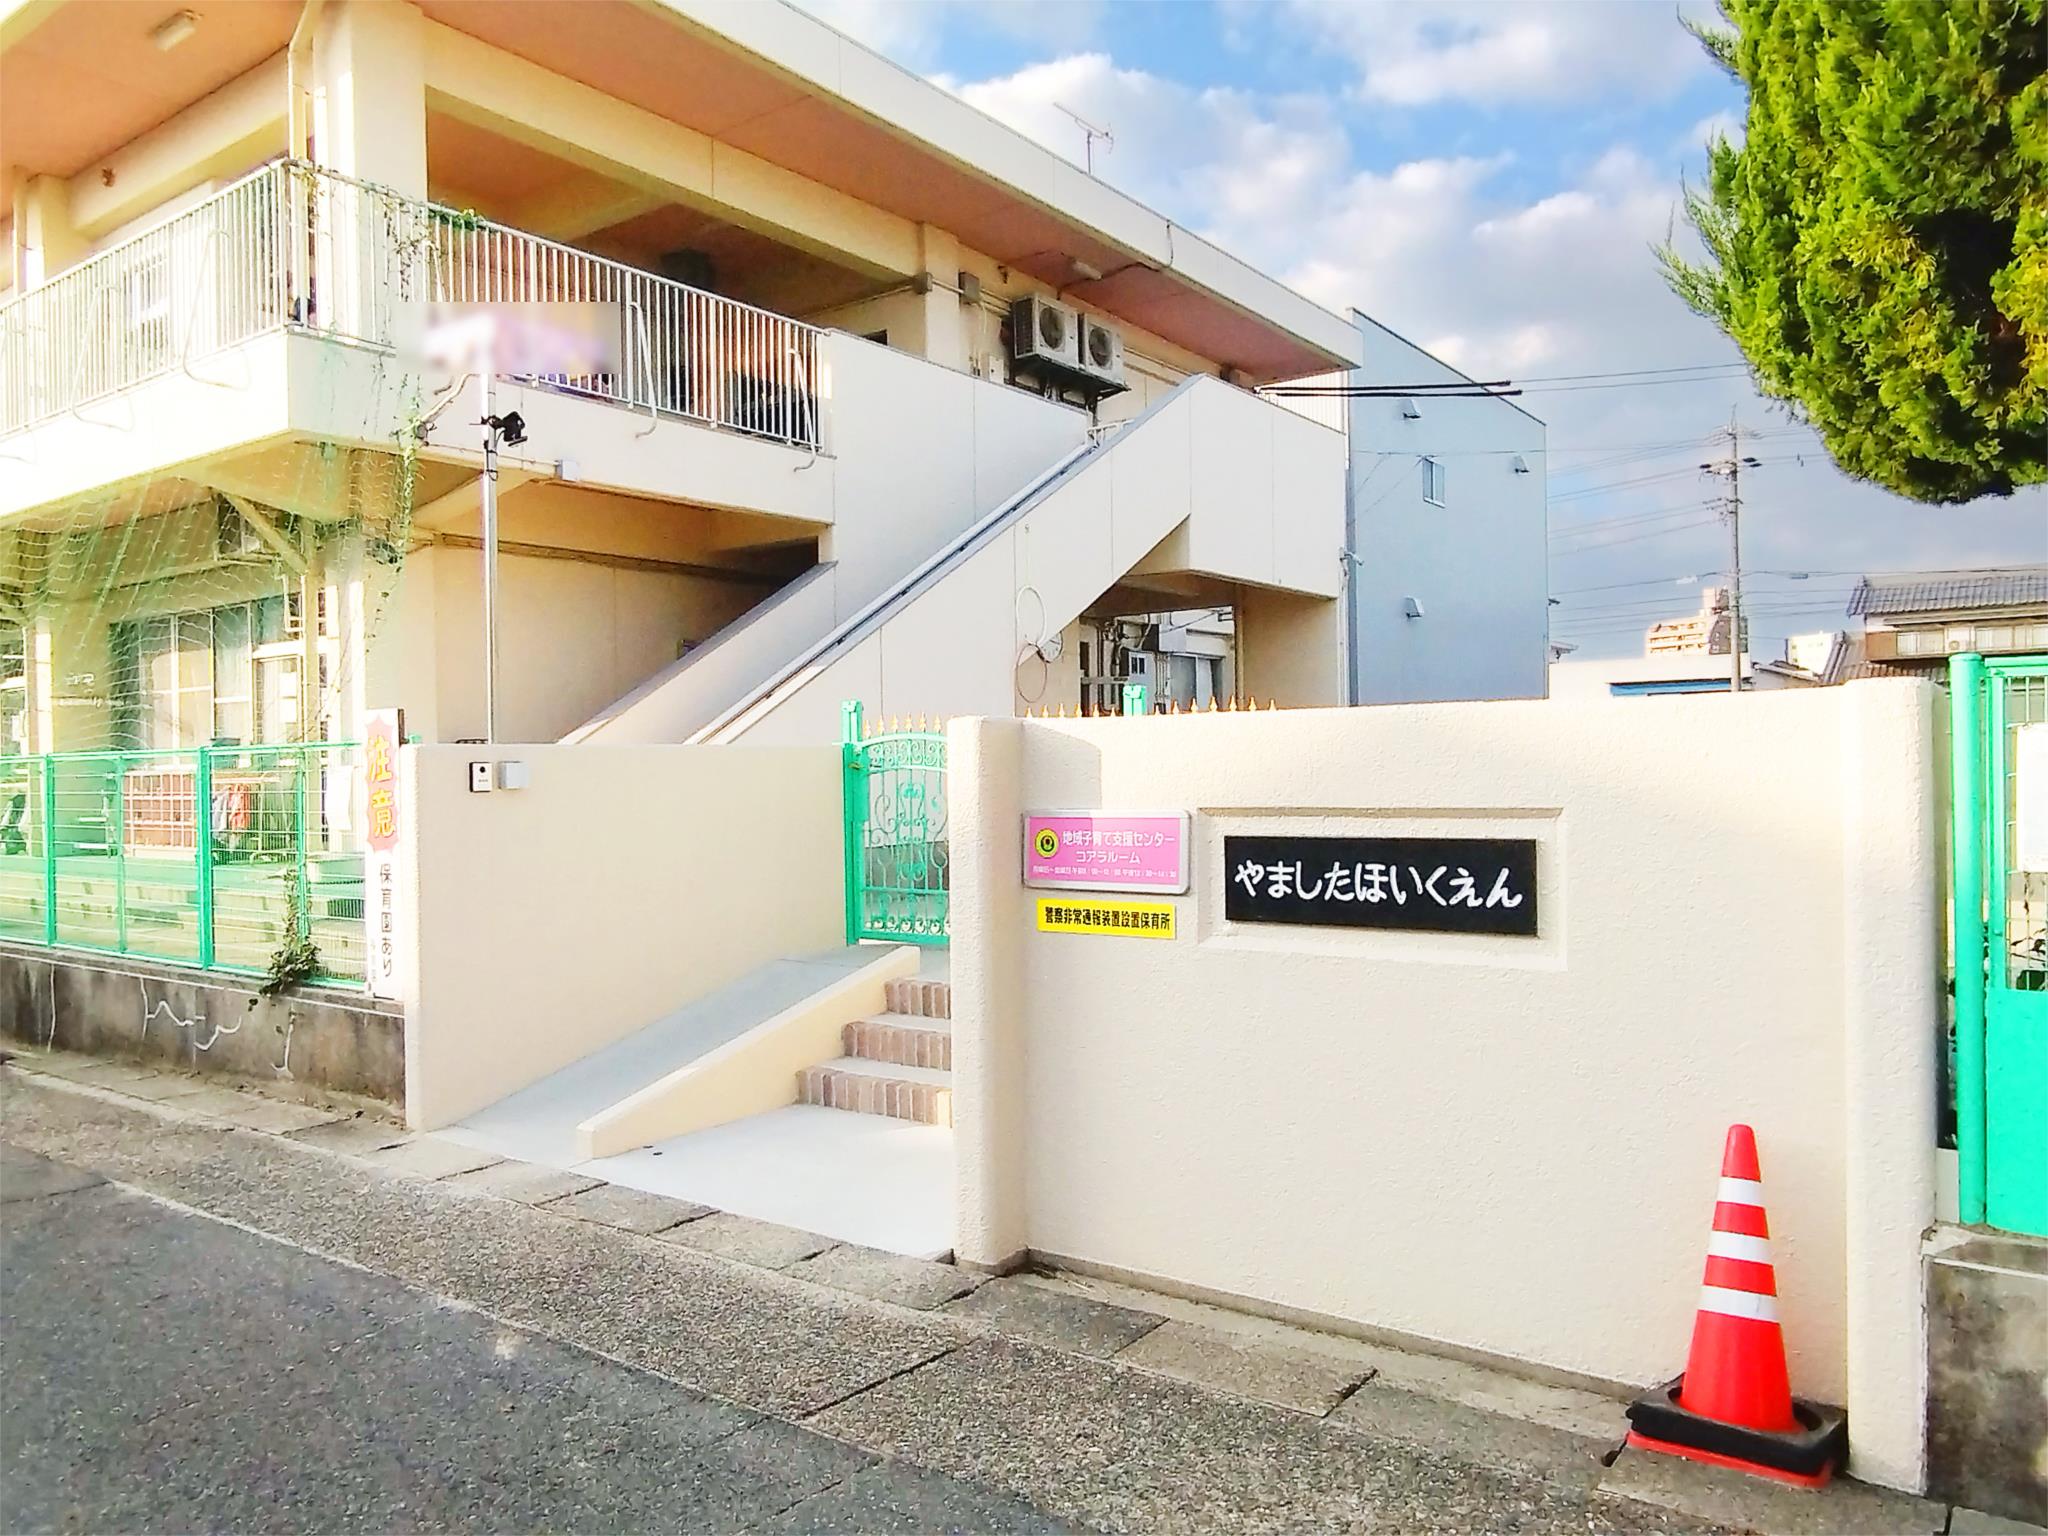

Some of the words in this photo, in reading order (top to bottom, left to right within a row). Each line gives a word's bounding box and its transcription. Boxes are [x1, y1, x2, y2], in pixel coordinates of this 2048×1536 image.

[367, 735, 395, 838] 注意
[1062, 830, 1176, 848] 地域子育て支援センター
[1076, 850, 1141, 865] コアラルーム
[1234, 859, 1523, 908] やましたほいくえん
[380, 863, 393, 977] 保育園あり
[1045, 906, 1170, 930] 警察非常通報装置設置保育所
